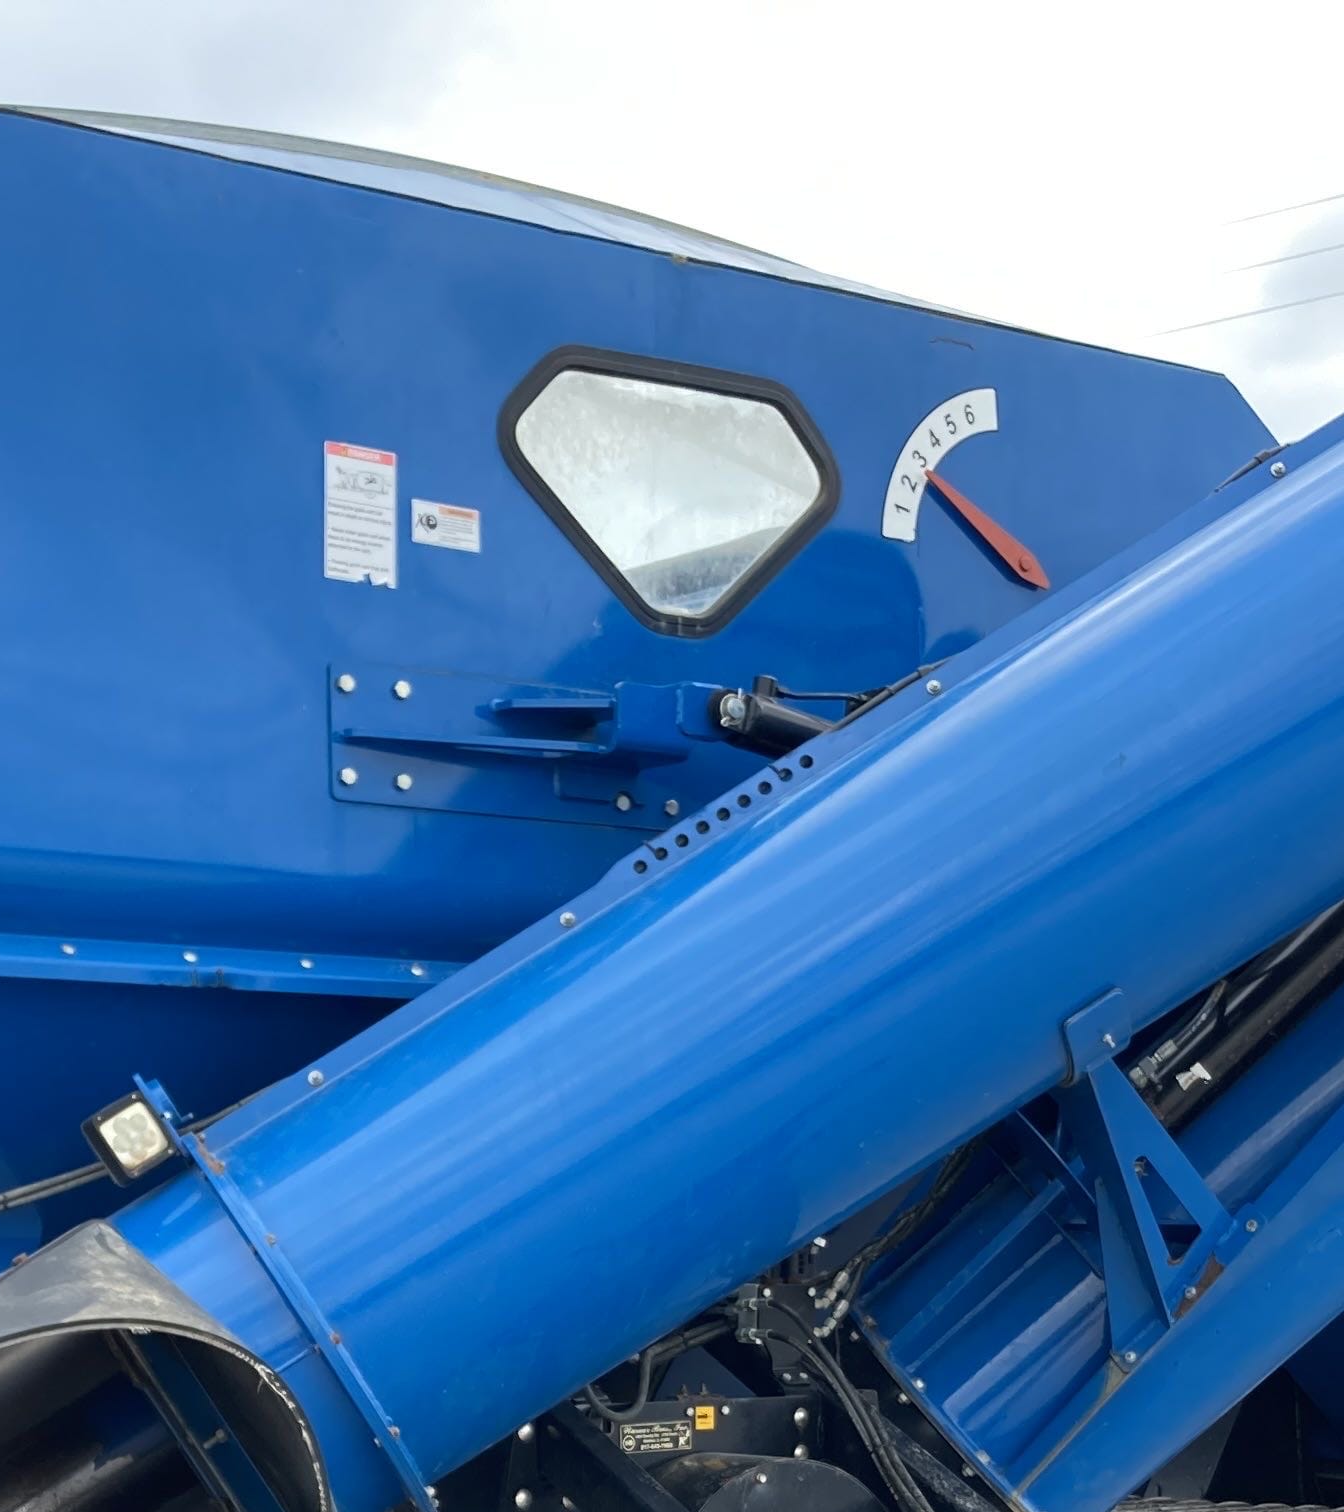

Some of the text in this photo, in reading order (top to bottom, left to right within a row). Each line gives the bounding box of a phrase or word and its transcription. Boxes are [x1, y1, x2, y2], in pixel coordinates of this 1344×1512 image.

[894, 404, 975, 514] 1 2 3 4 5 6
